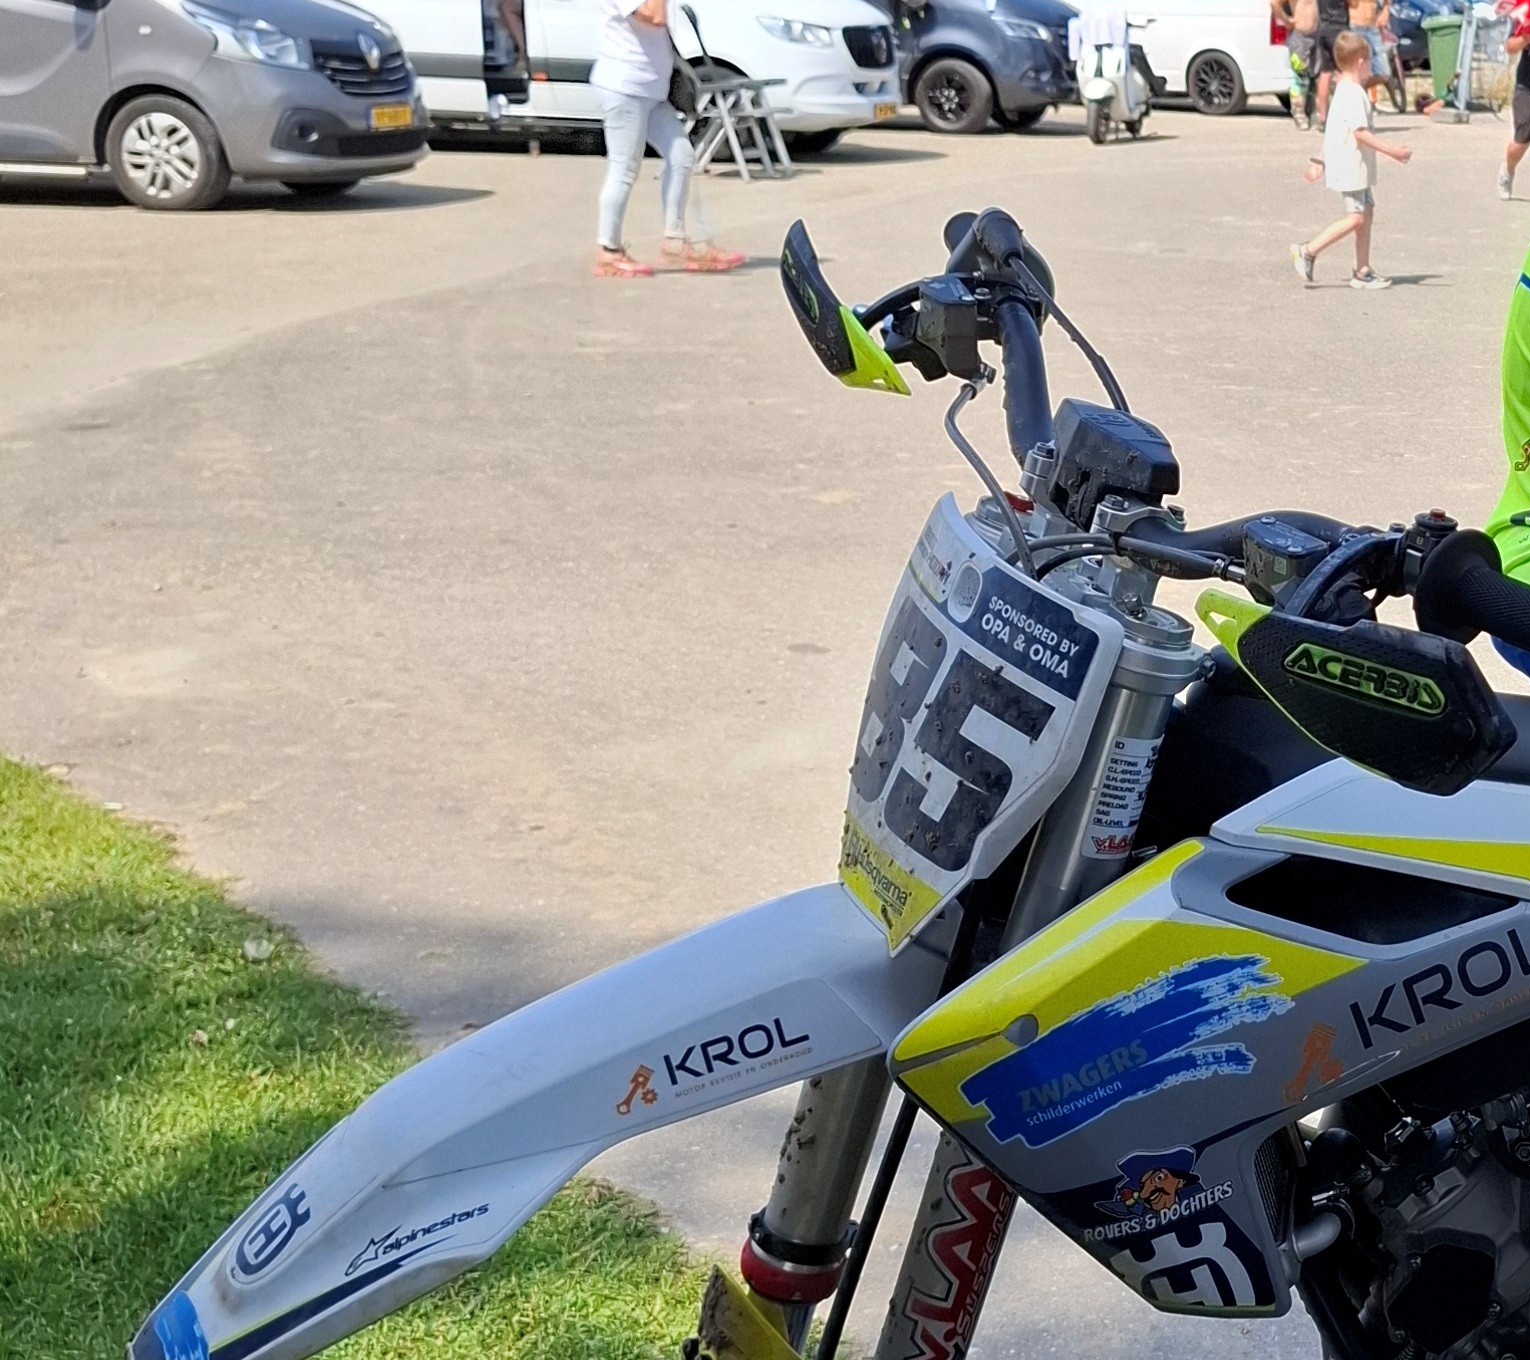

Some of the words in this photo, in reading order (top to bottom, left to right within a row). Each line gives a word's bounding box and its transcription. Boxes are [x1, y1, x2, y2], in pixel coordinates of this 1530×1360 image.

[981, 613, 1010, 643] OPA
[1013, 633, 1026, 652] &
[1029, 643, 1069, 678] OMA
[988, 596, 1058, 646] SPONSORED
[1059, 638, 1080, 657] BY
[852, 595, 1056, 873] 85
[663, 1017, 810, 1086] KROL
[1018, 1039, 1148, 1113] ZWAGERS
[1026, 1080, 1123, 1126] schilderwerken
[382, 1203, 490, 1256] alpinestars
[1084, 1217, 1141, 1243] ROVERS
[1144, 1213, 1157, 1230] &
[1160, 1179, 1234, 1226] DOCHTERS
